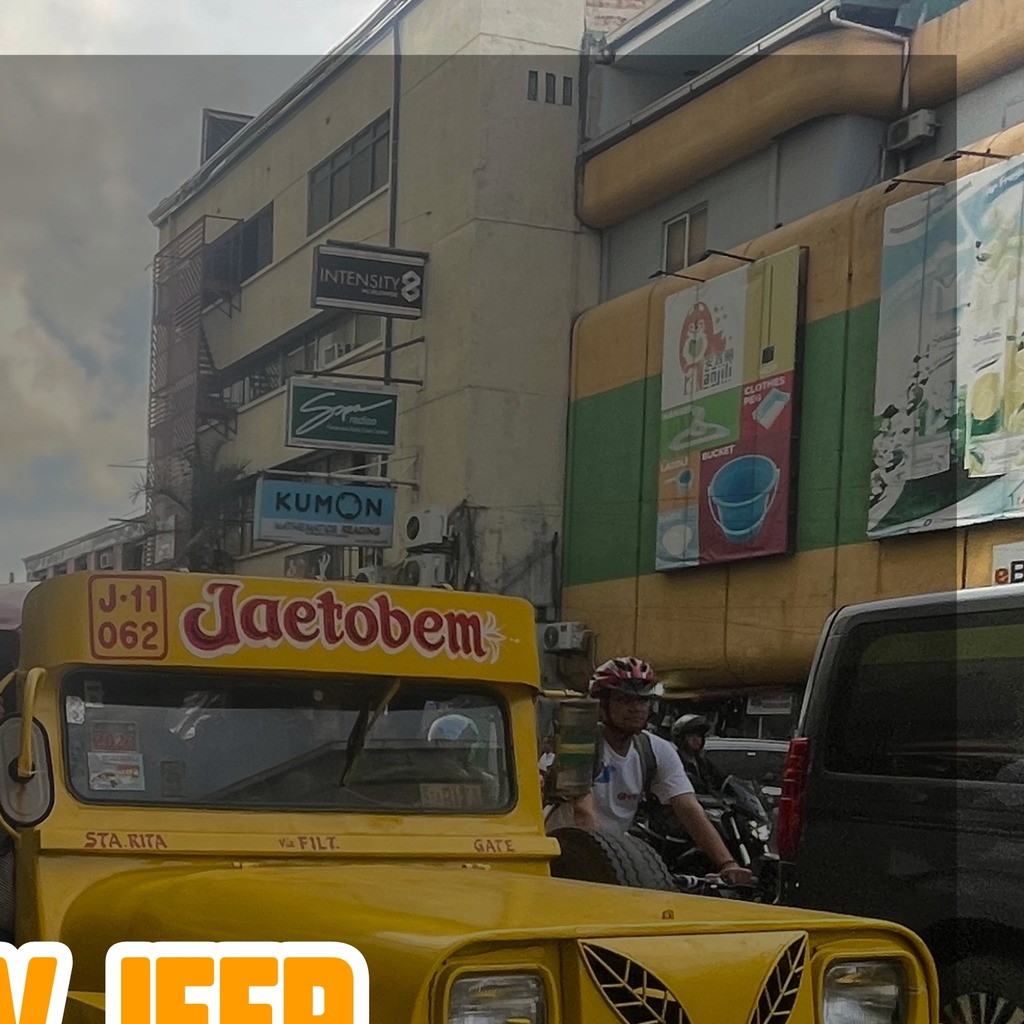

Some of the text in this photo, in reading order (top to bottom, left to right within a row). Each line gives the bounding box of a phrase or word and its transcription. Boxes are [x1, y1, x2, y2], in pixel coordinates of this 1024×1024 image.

[319, 267, 401, 291] INTENSITY
[743, 376, 787, 396] CLOTHES
[701, 444, 736, 461] BUCKET
[275, 491, 382, 520] KUMON
[178, 578, 492, 664] Jaetobem
[97, 620, 159, 651] 062
[473, 838, 516, 853] GATE
